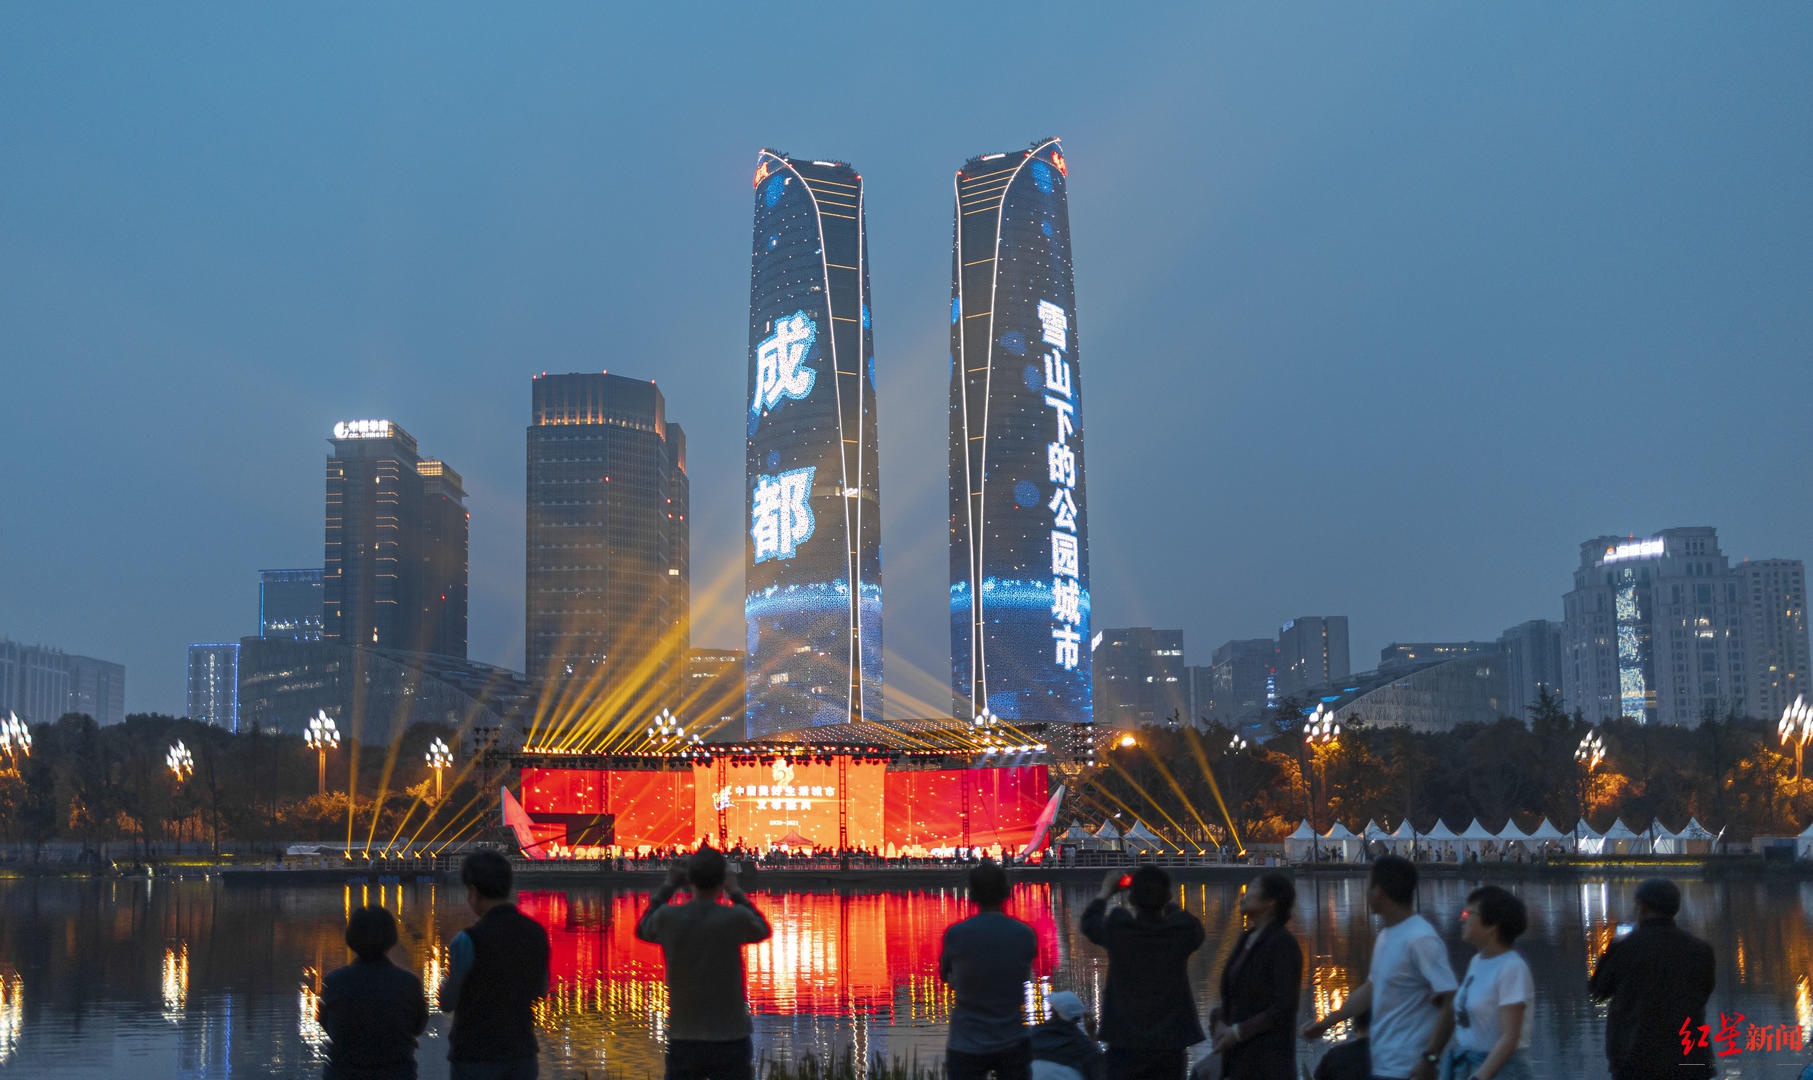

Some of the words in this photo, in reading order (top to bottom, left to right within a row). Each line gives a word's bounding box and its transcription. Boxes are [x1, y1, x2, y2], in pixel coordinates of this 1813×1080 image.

[751, 312, 816, 562] 成都
[1037, 299, 1081, 670] 雪山下的公园城市
